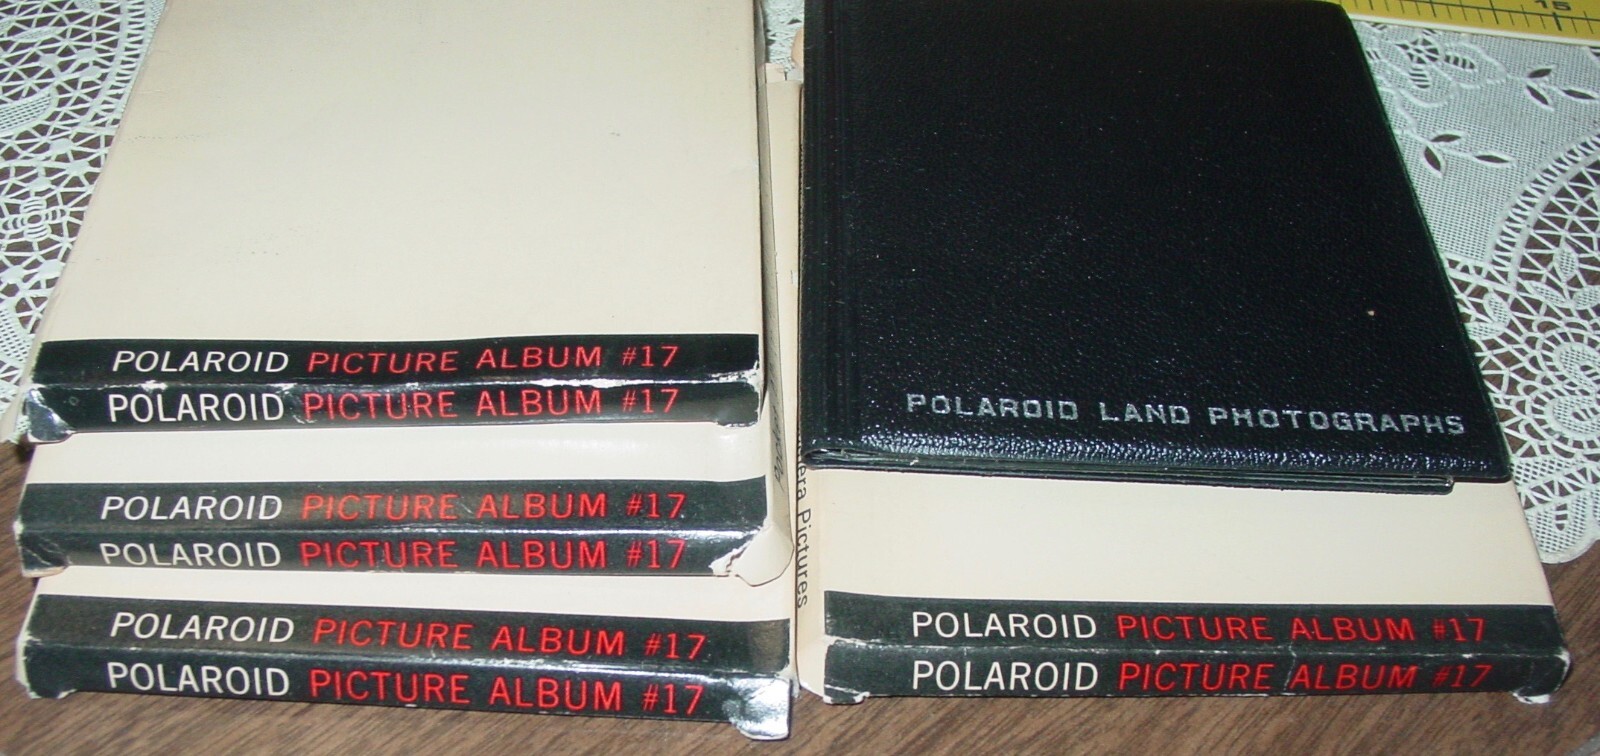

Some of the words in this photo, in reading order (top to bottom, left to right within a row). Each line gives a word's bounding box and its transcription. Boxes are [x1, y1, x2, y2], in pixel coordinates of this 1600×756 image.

[112, 351, 289, 373] POLAROID
[307, 351, 457, 375] PICTURE
[476, 346, 602, 369] ALBUM
[622, 345, 679, 368] #17
[108, 392, 284, 423] POLAROID
[303, 391, 457, 421] PICTURE
[476, 388, 602, 417] ALBUM
[622, 388, 679, 414] #17
[907, 393, 1079, 420] POLAROID
[1099, 401, 1190, 425] LAND
[1207, 406, 1465, 434] PHOTOGRAPHS
[100, 494, 283, 521] POLAROID
[301, 493, 458, 522] PICTURE
[475, 491, 608, 520] ALBUM
[626, 492, 687, 519] #17
[100, 541, 282, 568] POLAROID
[300, 539, 458, 570] PICTURE
[475, 539, 607, 571] ALBUM
[626, 538, 686, 570] #17
[796, 508, 812, 609] Pictures
[110, 611, 295, 644] POLAROID
[312, 617, 474, 651] PICTURE
[489, 625, 625, 656] ALBUM
[644, 632, 707, 660] #17
[911, 611, 1098, 640] POLAROID
[1116, 614, 1273, 641] PICTURE
[1291, 616, 1415, 642] ALBUM
[1432, 617, 1485, 642] #17
[107, 661, 290, 697] POLAROID
[308, 668, 471, 705] PICTURE
[488, 675, 622, 712] ALBUM
[642, 683, 706, 715] #17
[911, 659, 1099, 692] POLAROID
[1117, 661, 1275, 691] PICTURE
[1289, 663, 1419, 690] ALBUM
[1434, 664, 1492, 687] #17
